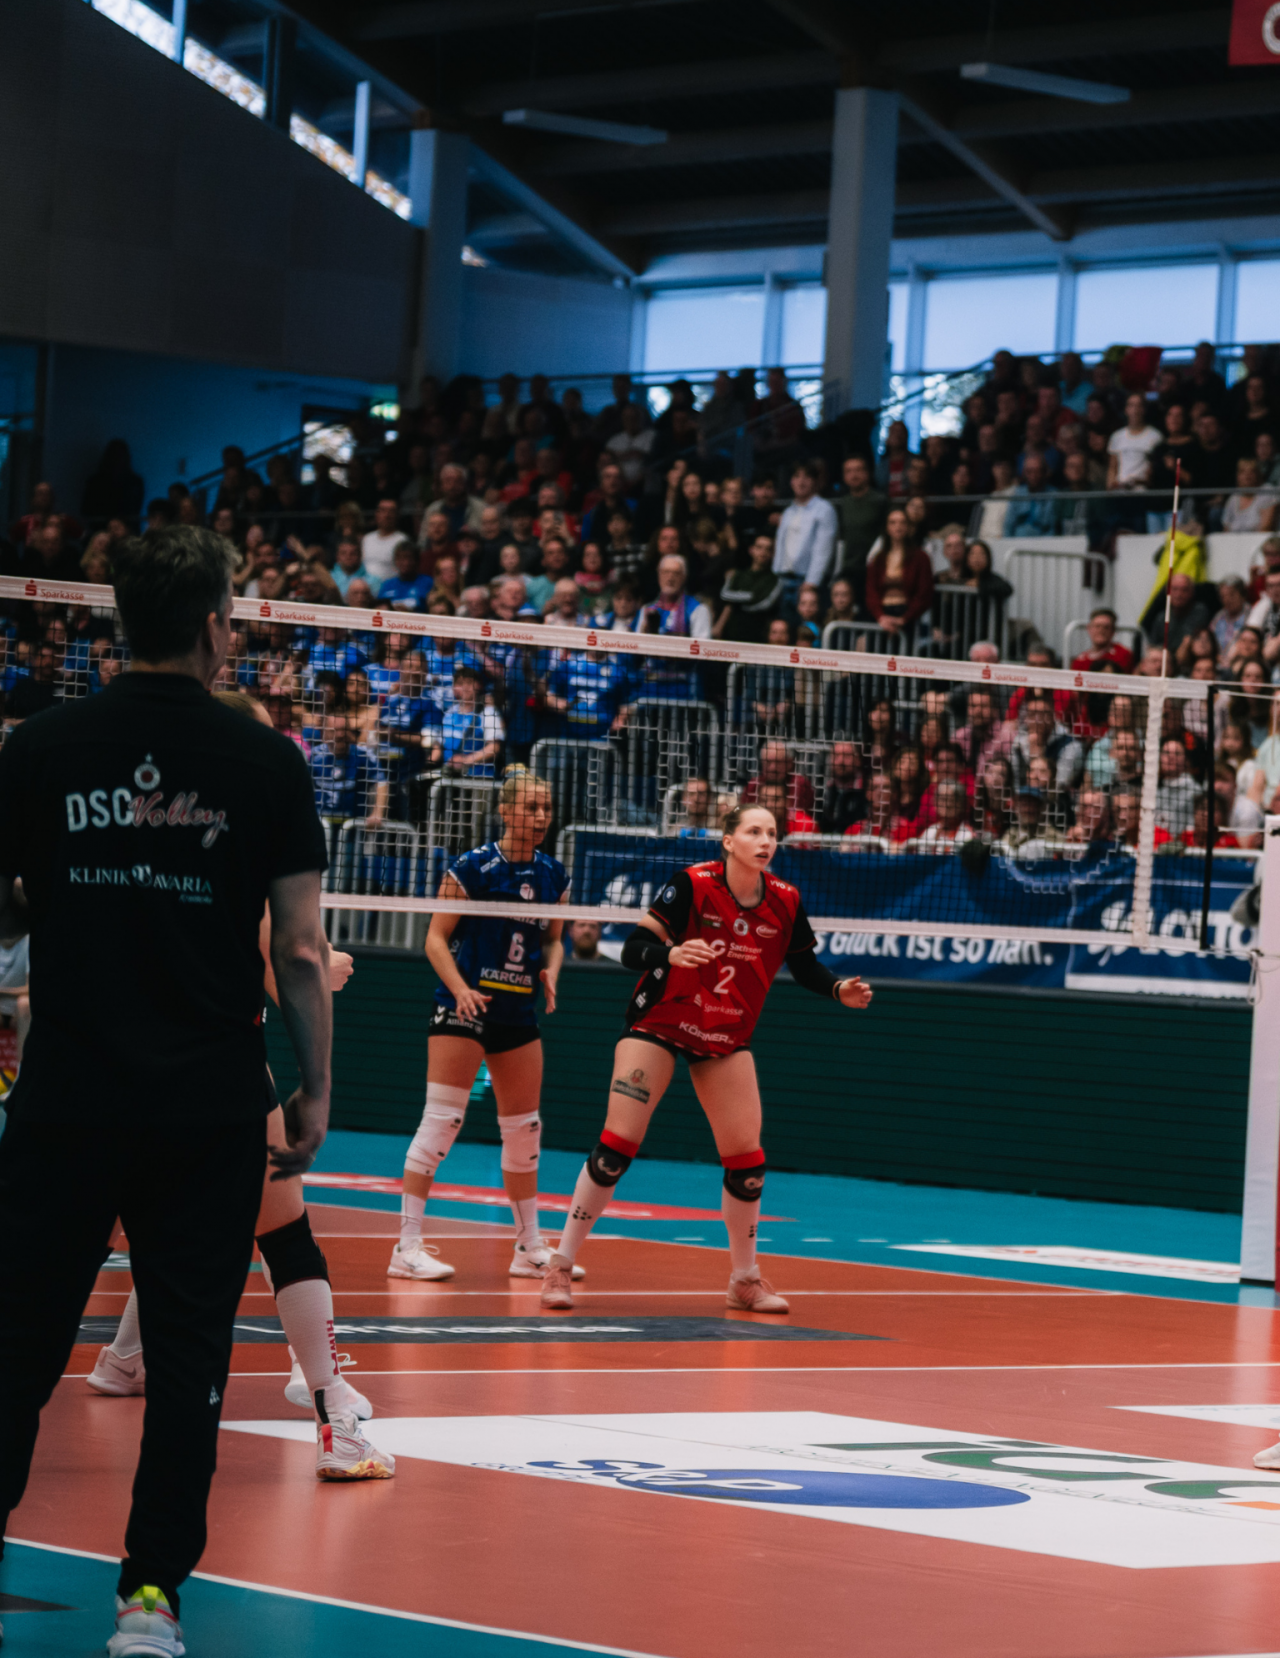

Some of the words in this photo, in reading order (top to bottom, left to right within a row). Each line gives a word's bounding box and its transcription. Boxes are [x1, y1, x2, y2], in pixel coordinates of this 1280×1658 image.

[70, 867, 131, 886] KLINIK
[508, 932, 524, 963] 6
[729, 942, 762, 954] Sachsen
[727, 951, 758, 962] Energie
[713, 965, 736, 995] 2
[704, 1003, 744, 1017] Sparkasse
